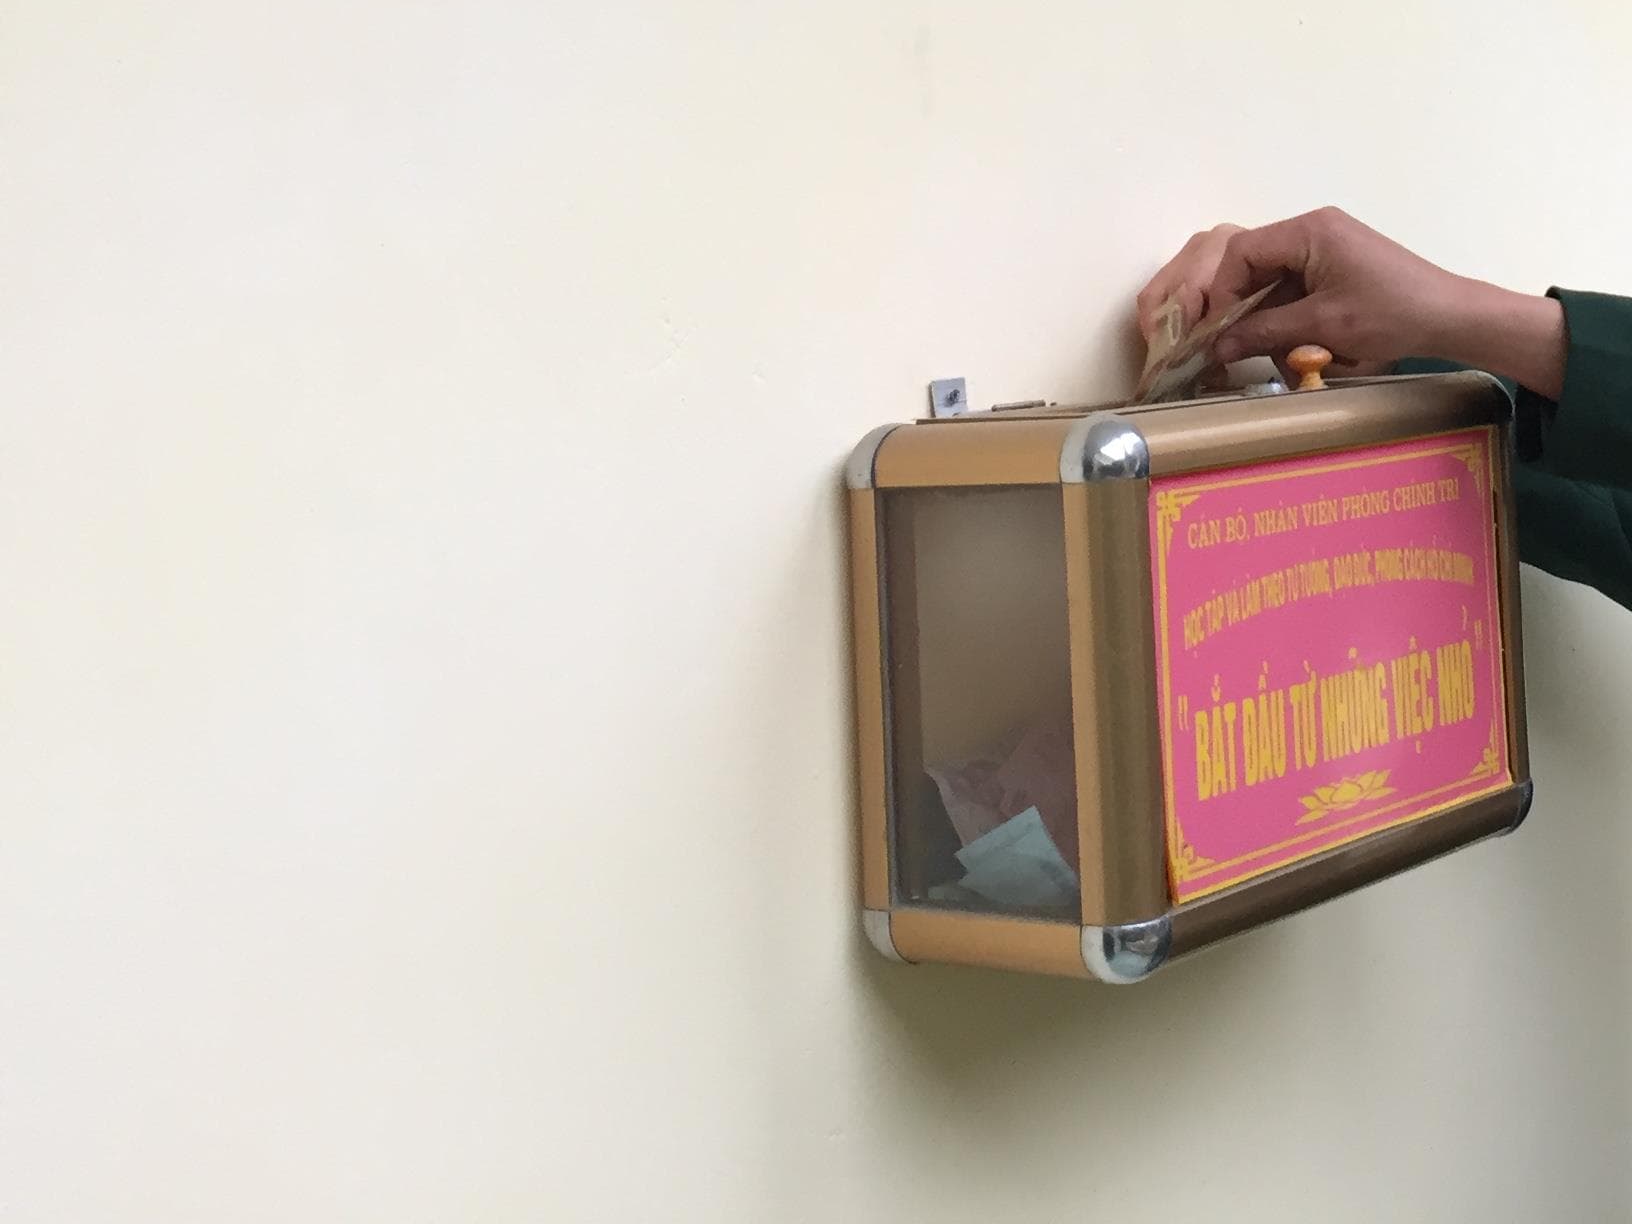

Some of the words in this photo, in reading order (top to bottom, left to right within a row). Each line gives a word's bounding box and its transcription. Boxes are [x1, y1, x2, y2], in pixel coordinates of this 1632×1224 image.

[1188, 513, 1221, 549] CÁN
[1254, 500, 1298, 537] NHÂN
[1302, 493, 1338, 526] VIÊN
[1342, 485, 1390, 521] PHÒNG
[1393, 478, 1436, 511] CHÍNH
[1184, 605, 1205, 658] HỌC
[1225, 579, 1240, 627] VÀ
[1240, 573, 1262, 620] LÀM
[1262, 570, 1285, 609] THEO
[1242, 660, 1286, 786] ĐẦU
[1289, 660, 1317, 770] TỪ
[1320, 647, 1389, 762] NHỮNG
[1391, 636, 1434, 754] VIỆC
